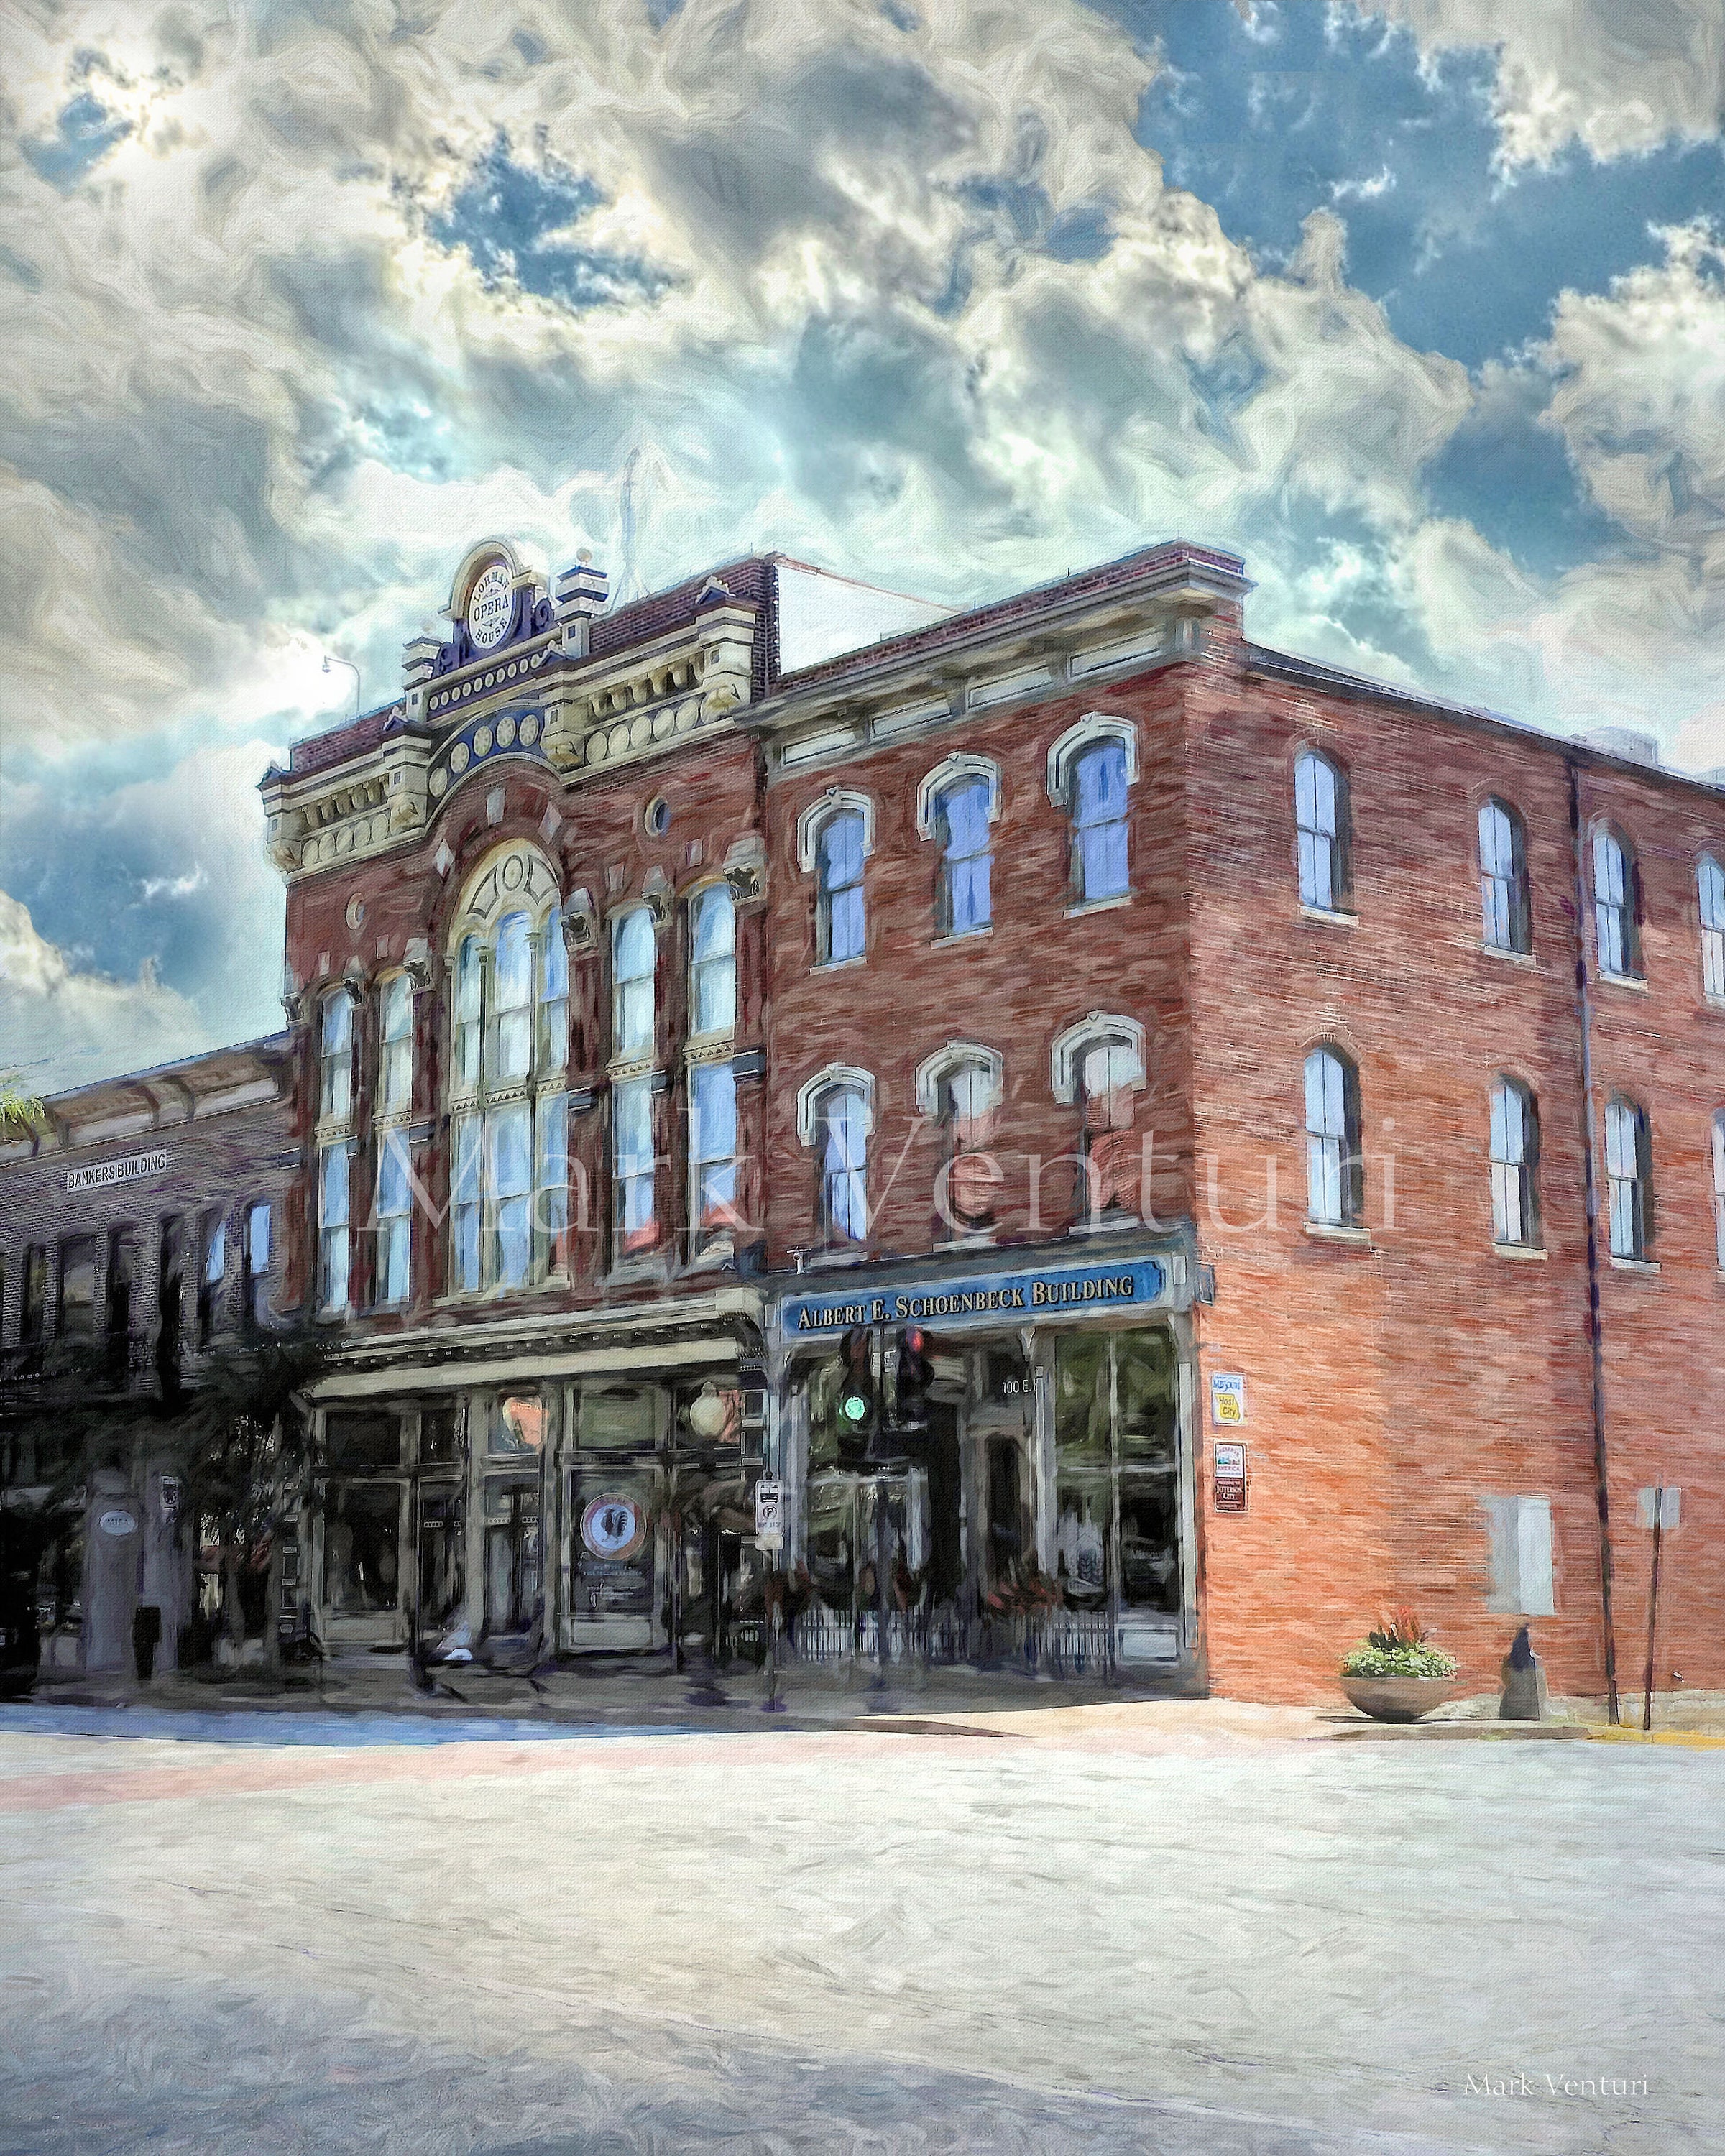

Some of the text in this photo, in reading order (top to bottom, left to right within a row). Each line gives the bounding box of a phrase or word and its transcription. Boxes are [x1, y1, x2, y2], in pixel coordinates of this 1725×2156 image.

[474, 594, 509, 622] OPERA
[475, 617, 507, 644] HOUSE
[68, 1153, 166, 1189] BANKERS BUILDING
[798, 1276, 1134, 1329] ALBERT E. SCHOENBECK BUILDING
[1003, 1381, 1020, 1393] 100
